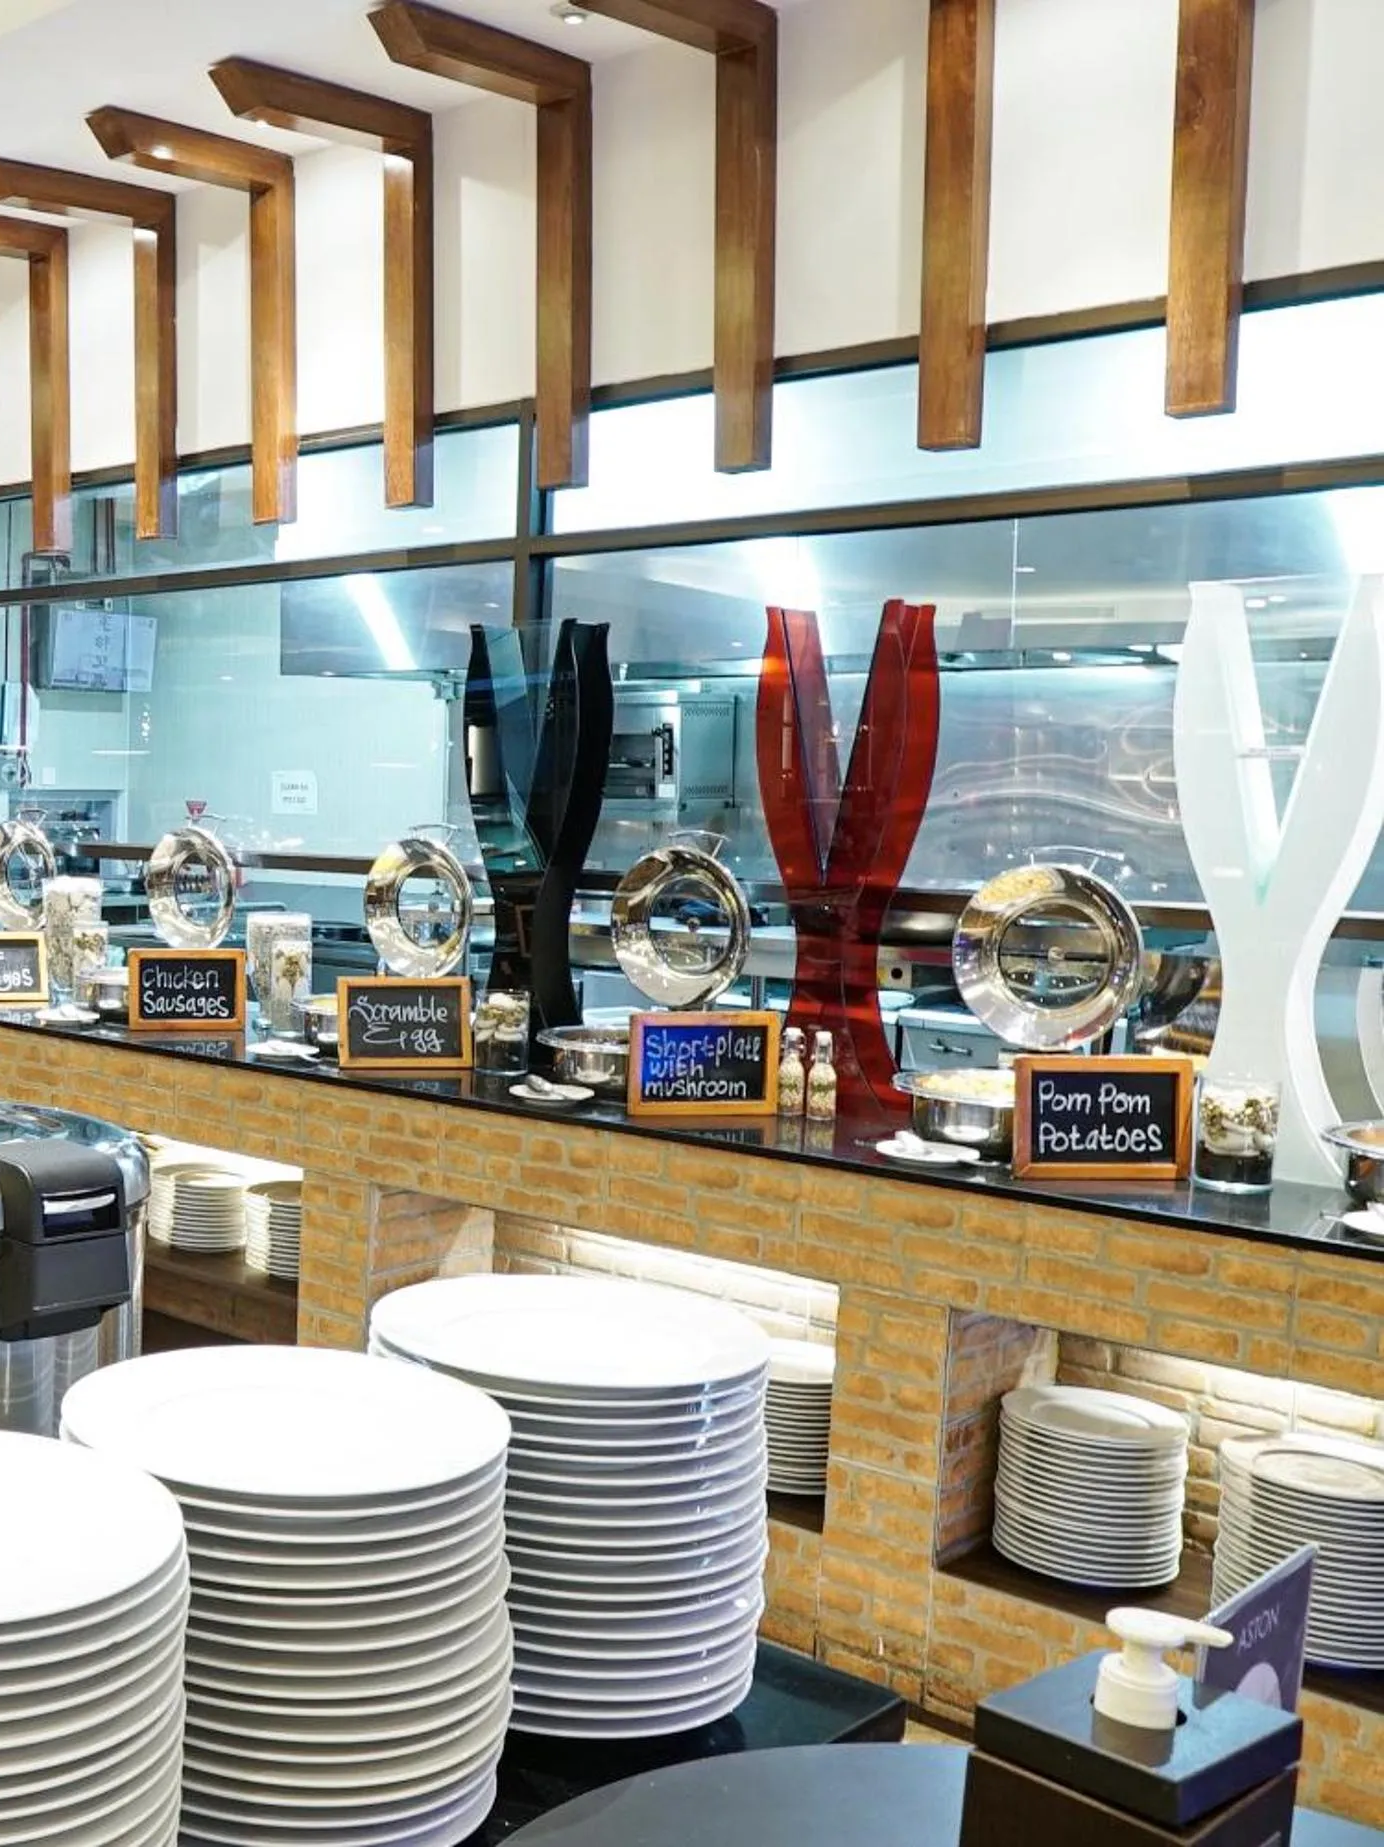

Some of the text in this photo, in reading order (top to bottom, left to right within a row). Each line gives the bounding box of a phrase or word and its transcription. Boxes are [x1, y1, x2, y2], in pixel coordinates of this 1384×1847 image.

[142, 965, 219, 990] Chicken
[143, 991, 230, 1018] Sausages
[348, 995, 449, 1023] Scramble
[645, 1077, 747, 1099] mushroom
[1038, 1080, 1152, 1116] Pom Pom
[1038, 1121, 1164, 1154] Potatoes
